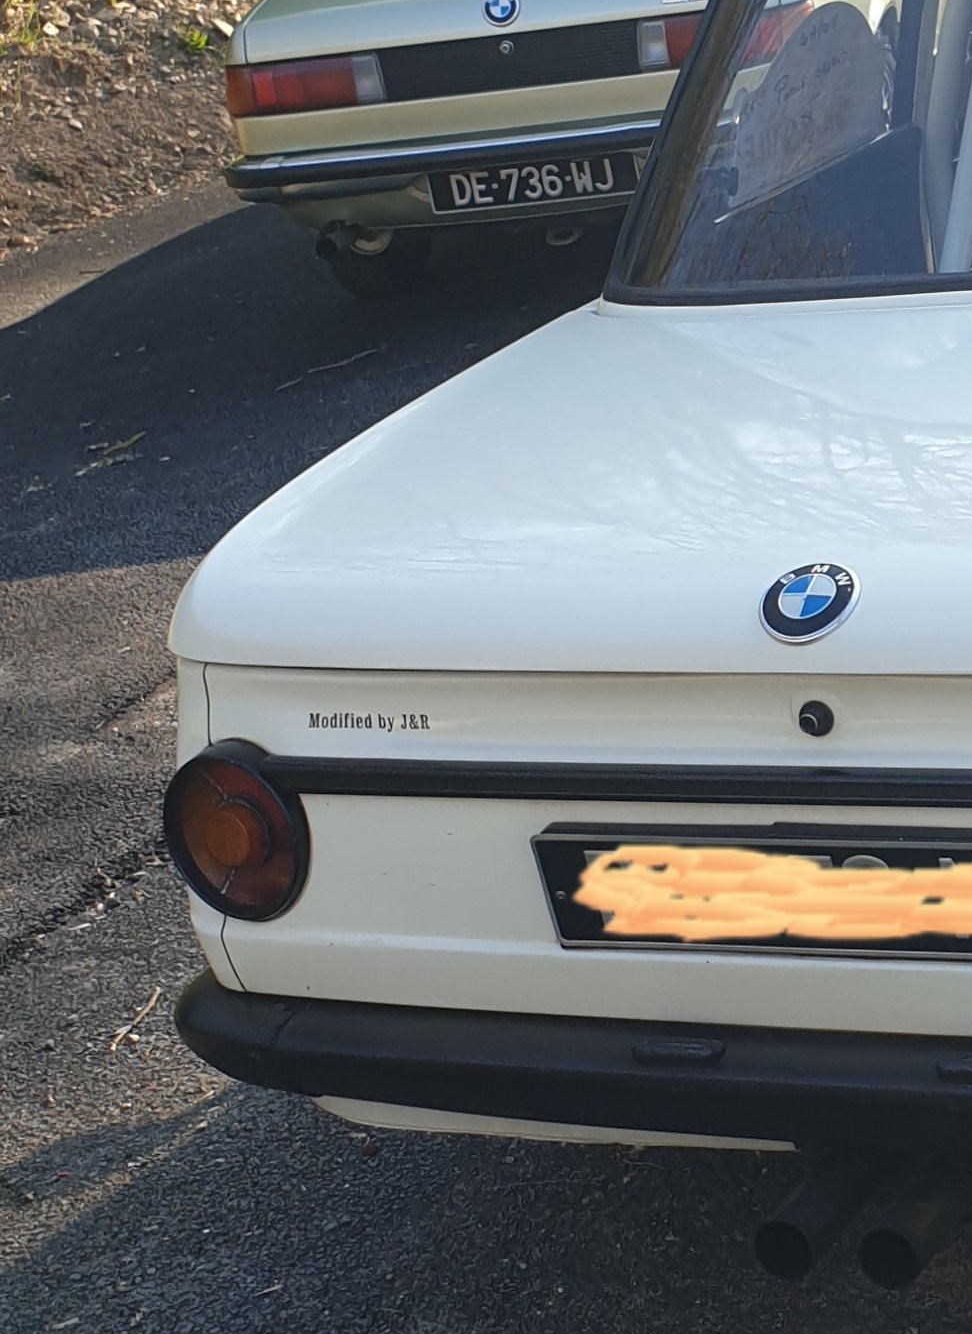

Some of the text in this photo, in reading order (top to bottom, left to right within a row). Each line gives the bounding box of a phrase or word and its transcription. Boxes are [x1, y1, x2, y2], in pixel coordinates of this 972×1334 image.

[449, 158, 614, 207] DE-736-WJ
[779, 564, 852, 586] BMW
[308, 712, 431, 733] Modified by J&R
